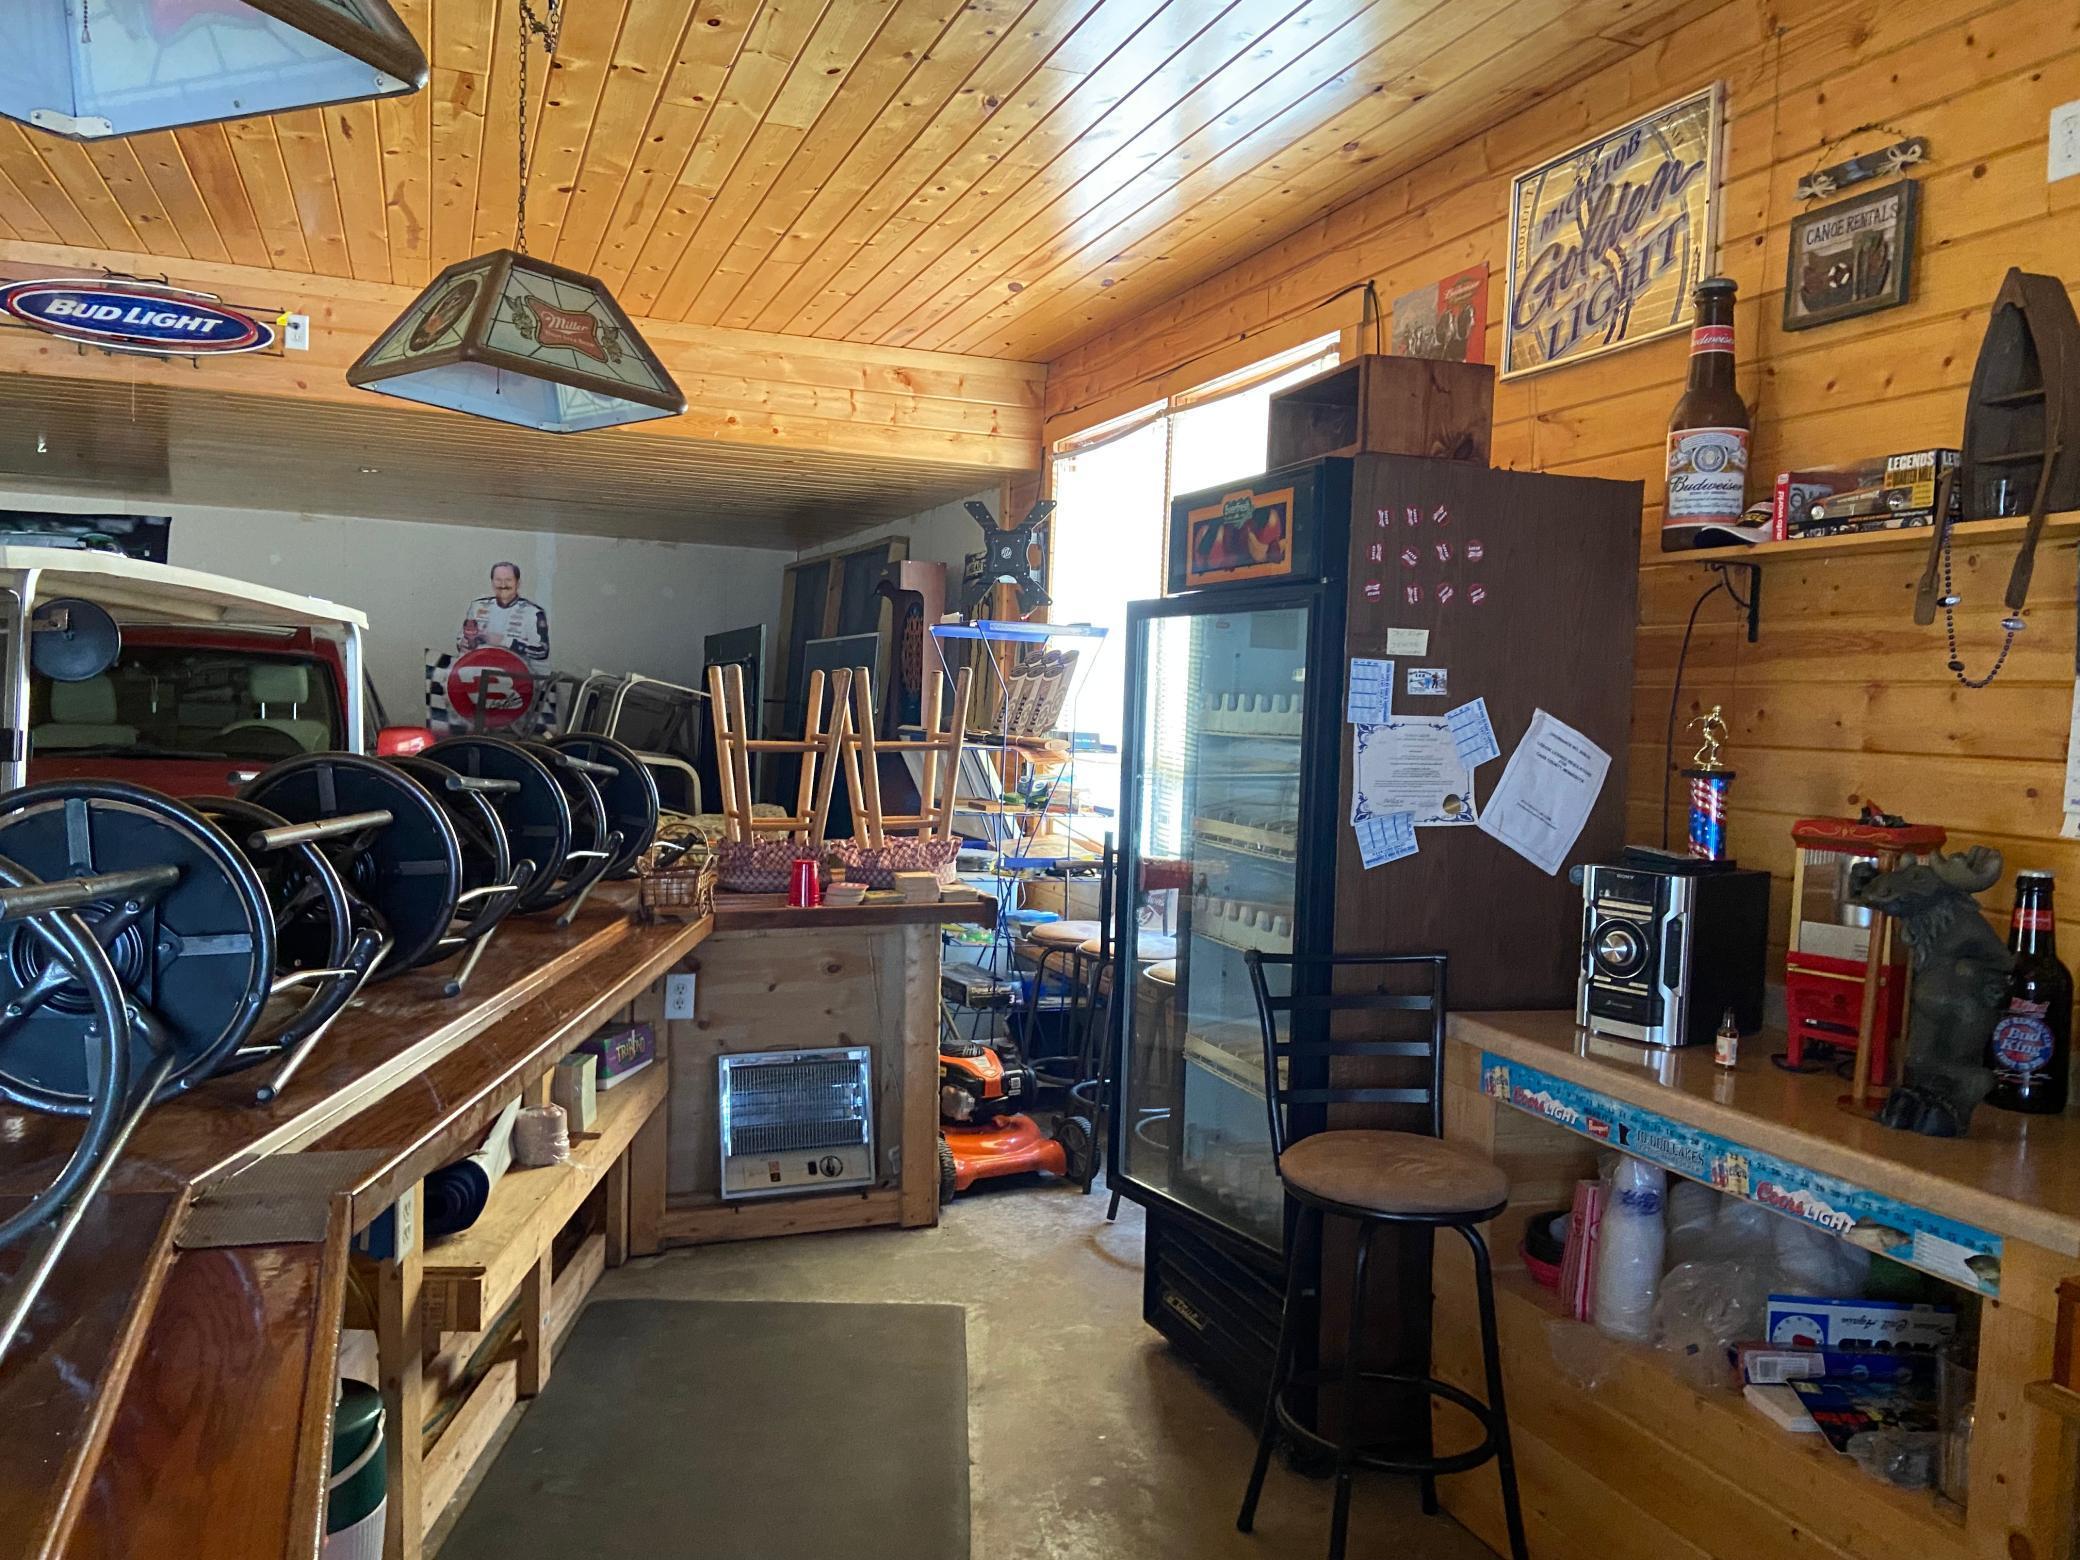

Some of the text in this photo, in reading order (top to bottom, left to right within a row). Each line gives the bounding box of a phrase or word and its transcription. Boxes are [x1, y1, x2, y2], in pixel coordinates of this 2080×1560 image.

[1806, 203, 1899, 245] CANOE RENTALS
[1512, 159, 1705, 331] Golden
[1548, 211, 1690, 360] LIGHT
[44, 298, 223, 333] BUD LIGHT
[541, 310, 588, 331] Miller
[1887, 451, 1936, 471] LEGENDS
[1669, 475, 1743, 493] Budweiser
[1777, 491, 1785, 519] world
[2007, 1026, 2042, 1043] Bud
[2000, 1038, 2042, 1058] King
[1544, 1103, 1579, 1125] LIGHT
[1756, 1181, 1857, 1233] Coors LIGHT
